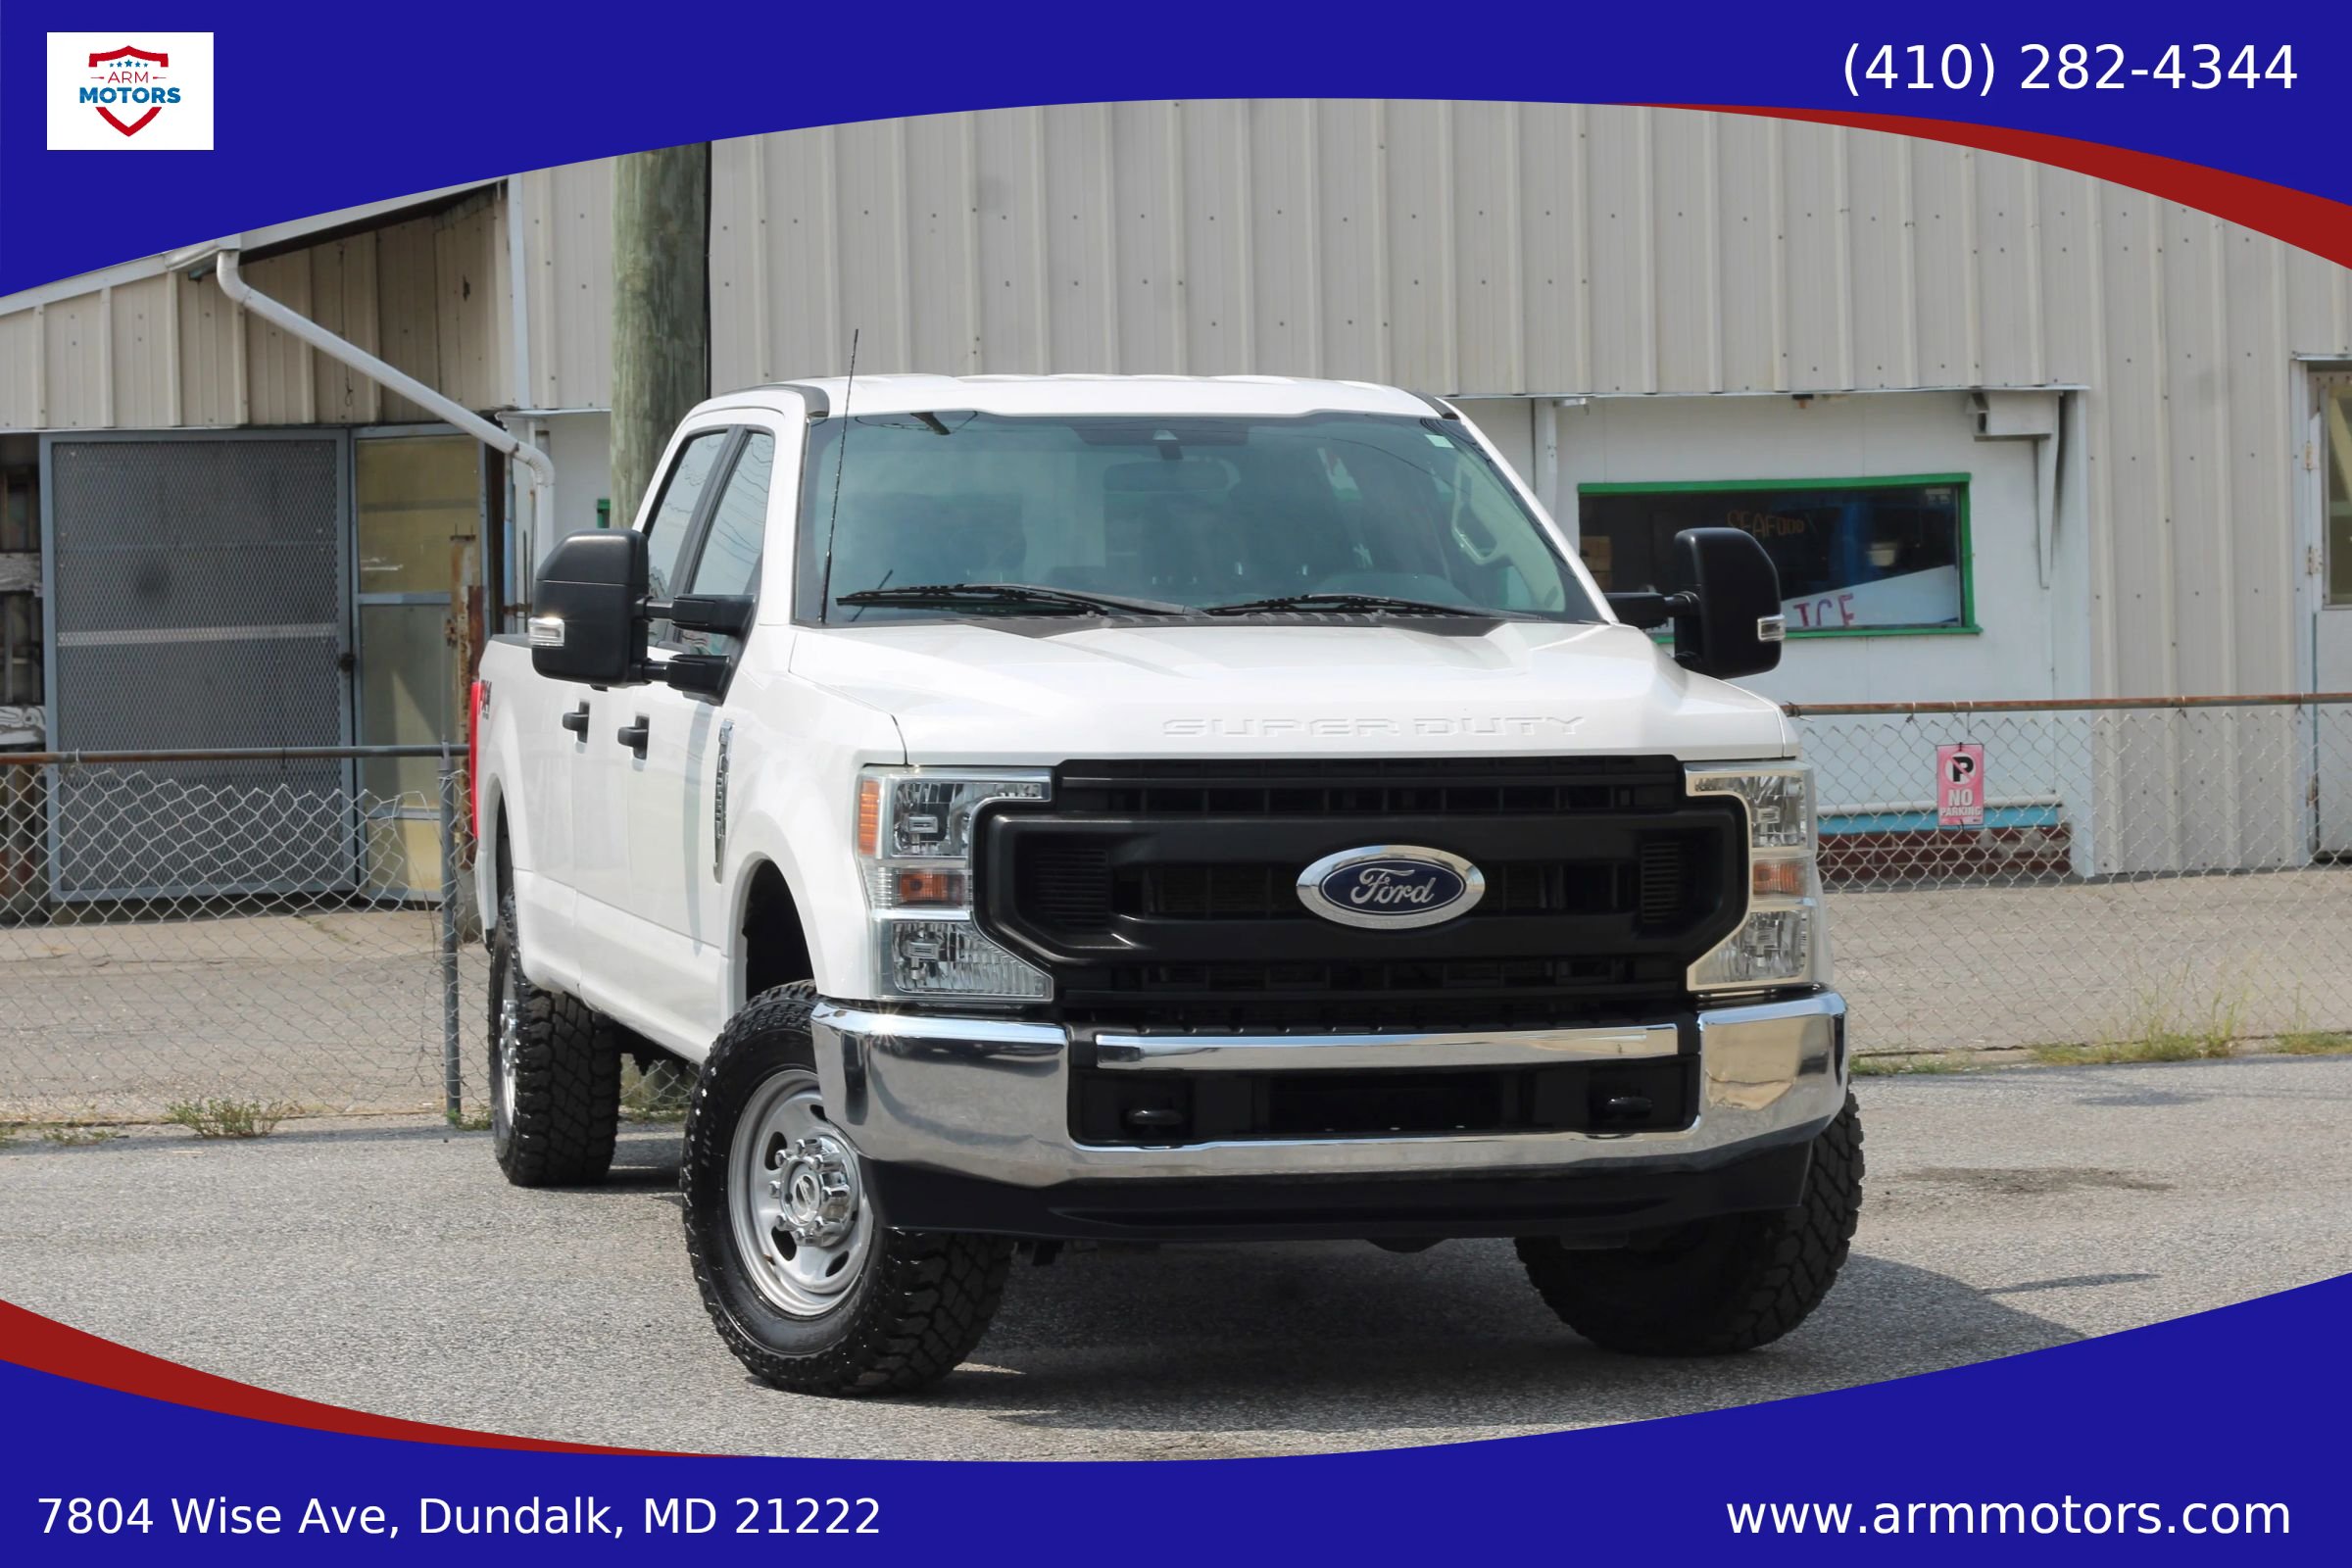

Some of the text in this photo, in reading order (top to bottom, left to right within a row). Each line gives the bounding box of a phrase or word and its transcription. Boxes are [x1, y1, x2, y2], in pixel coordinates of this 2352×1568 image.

[1792, 593, 1856, 626] ICE
[1162, 715, 1585, 738] SUPER DUTY
[1948, 788, 1974, 807] NO
[1940, 806, 1983, 816] PARKING
[1349, 867, 1435, 905] Ford
